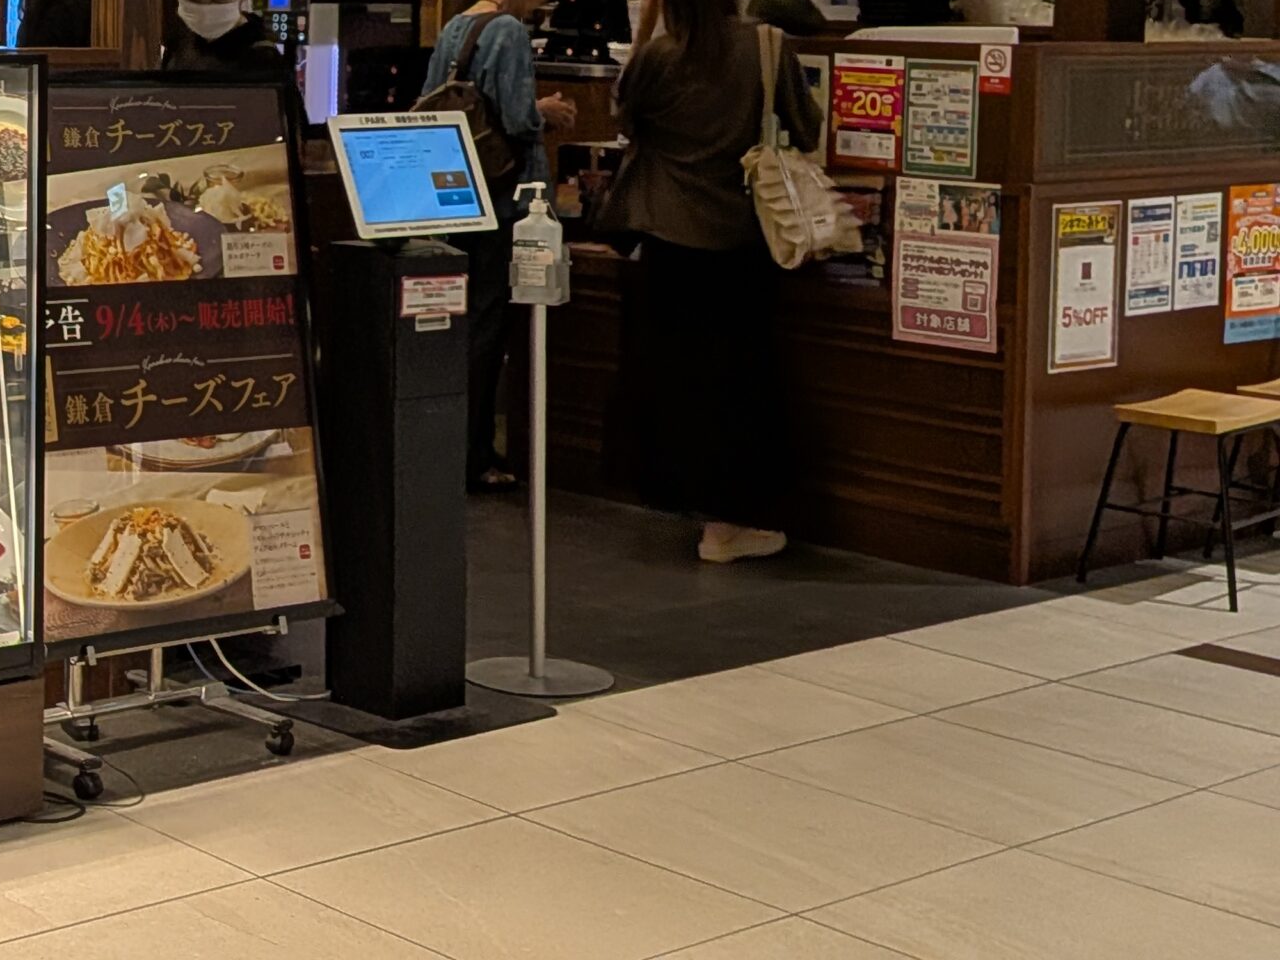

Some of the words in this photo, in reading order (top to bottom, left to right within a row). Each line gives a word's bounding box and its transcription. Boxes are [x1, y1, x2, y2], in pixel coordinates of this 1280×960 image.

[63, 118, 236, 153] 鎌倉チーズフェア
[915, 312, 971, 332] 対象店舗
[1061, 306, 1108, 328] 5%OFF
[64, 373, 297, 430] 鎌倉チーズフェア
